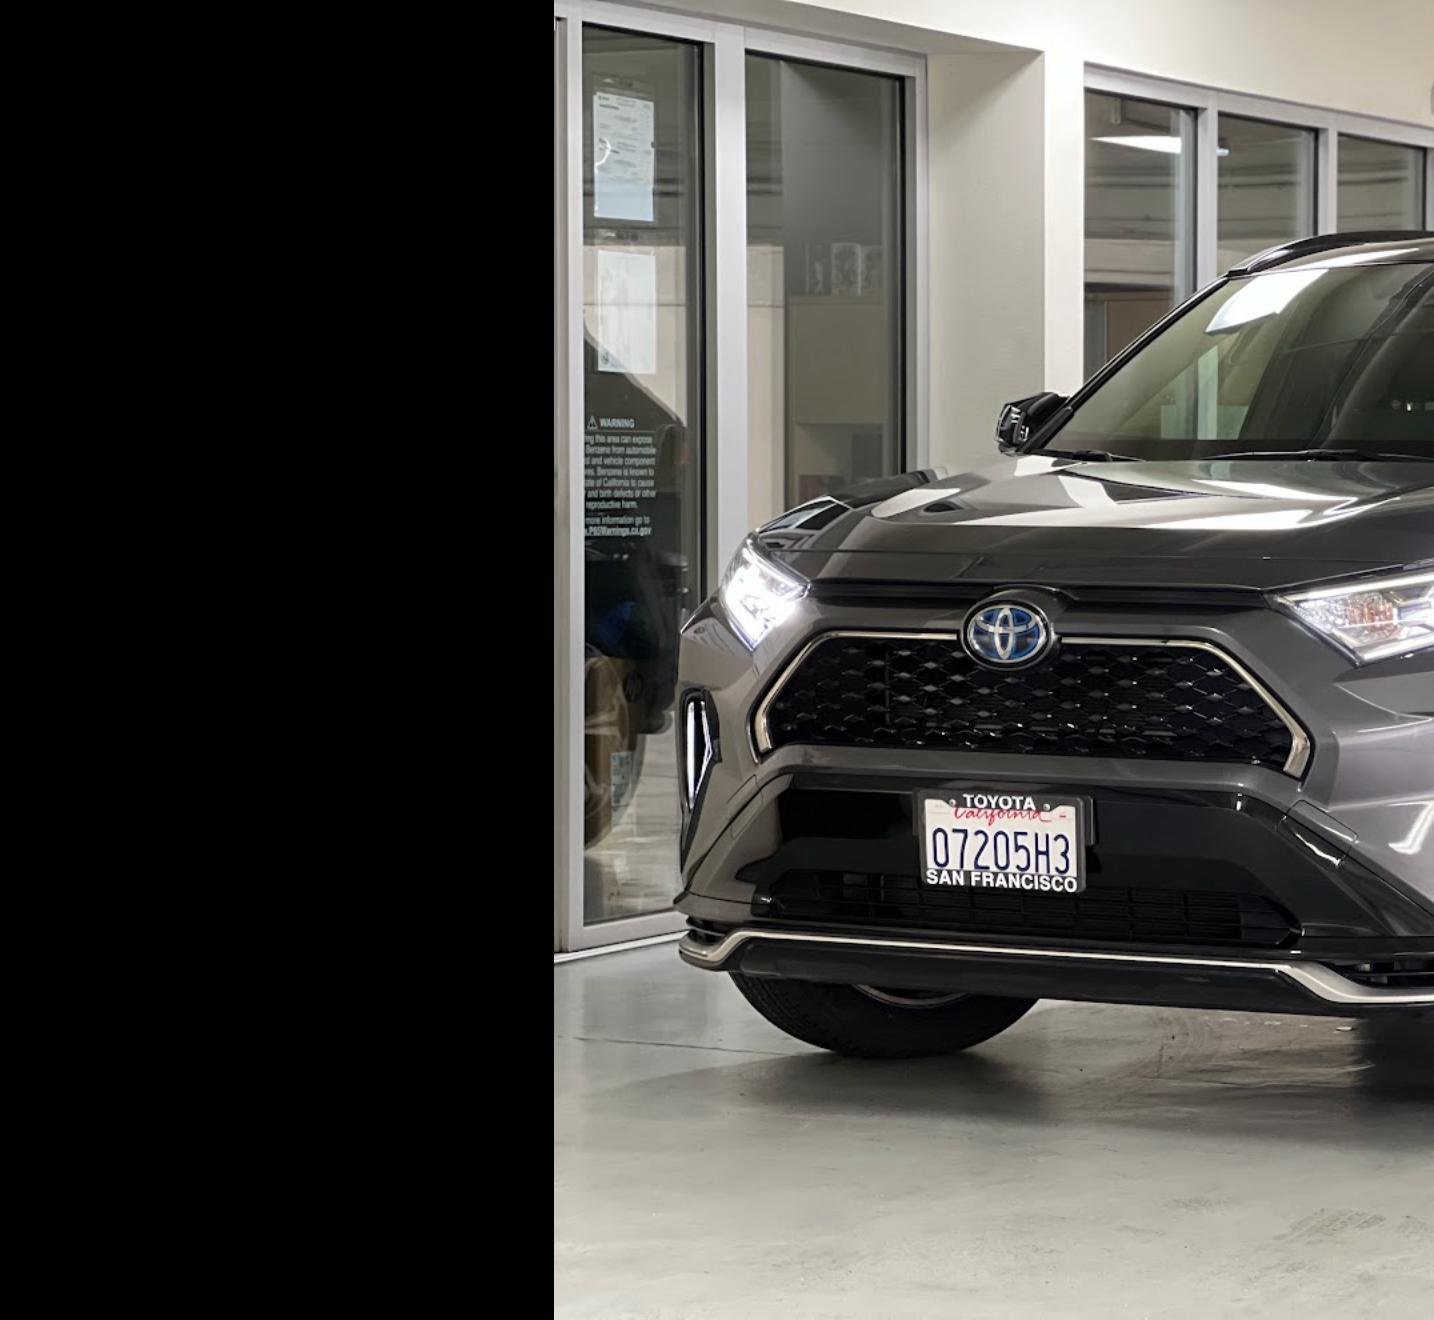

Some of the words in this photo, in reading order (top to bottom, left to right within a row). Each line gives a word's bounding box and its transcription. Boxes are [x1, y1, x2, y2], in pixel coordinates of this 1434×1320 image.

[600, 418, 635, 428] WARNING
[595, 434, 605, 443] this
[632, 436, 653, 445] expose
[586, 445, 611, 454] Benzene
[611, 446, 625, 454] from
[626, 446, 656, 454] automobile
[591, 456, 602, 465] and
[603, 456, 623, 465] vehicle
[624, 457, 656, 466] component
[597, 467, 622, 476] Benzene
[629, 467, 647, 476] known
[648, 468, 654, 476] to
[603, 477, 630, 487] California
[631, 478, 637, 487] to
[638, 479, 655, 487] cause
[587, 489, 599, 497] and
[613, 489, 634, 498] defects
[641, 489, 656, 498] other
[586, 500, 621, 509] reproductive
[621, 500, 639, 509] harm.
[585, 516, 601, 525] more
[602, 515, 634, 525] information
[635, 517, 642, 526] go
[643, 515, 650, 525] to
[963, 794, 1036, 810] TOYOTA
[952, 806, 1052, 826] California
[932, 827, 1070, 875] 07205H3
[926, 869, 964, 886] SAN
[971, 872, 1078, 893] FRANCISCO
